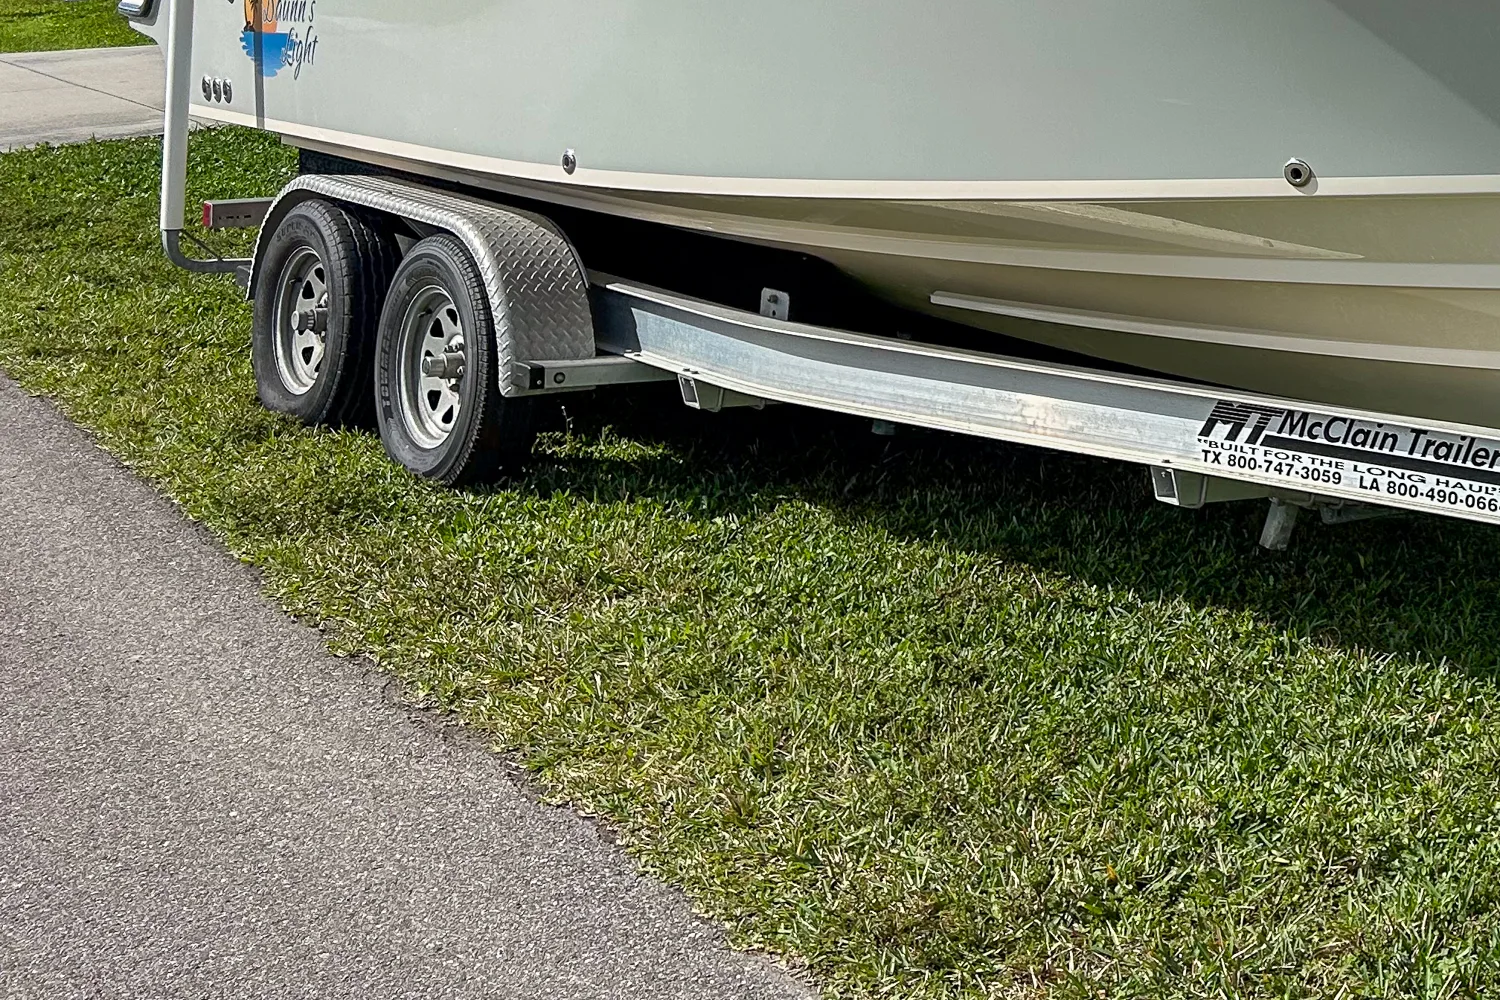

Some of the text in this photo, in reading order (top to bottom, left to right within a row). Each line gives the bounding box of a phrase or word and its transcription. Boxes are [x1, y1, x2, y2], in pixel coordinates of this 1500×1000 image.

[1198, 399, 1285, 446] MT
[1277, 409, 1399, 453] McClain
[1201, 449, 1222, 465] TX
[1359, 475, 1380, 492] LA
[1263, 449, 1303, 464] FOR
[1308, 456, 1345, 471] THE
[1352, 464, 1427, 485] LONG
